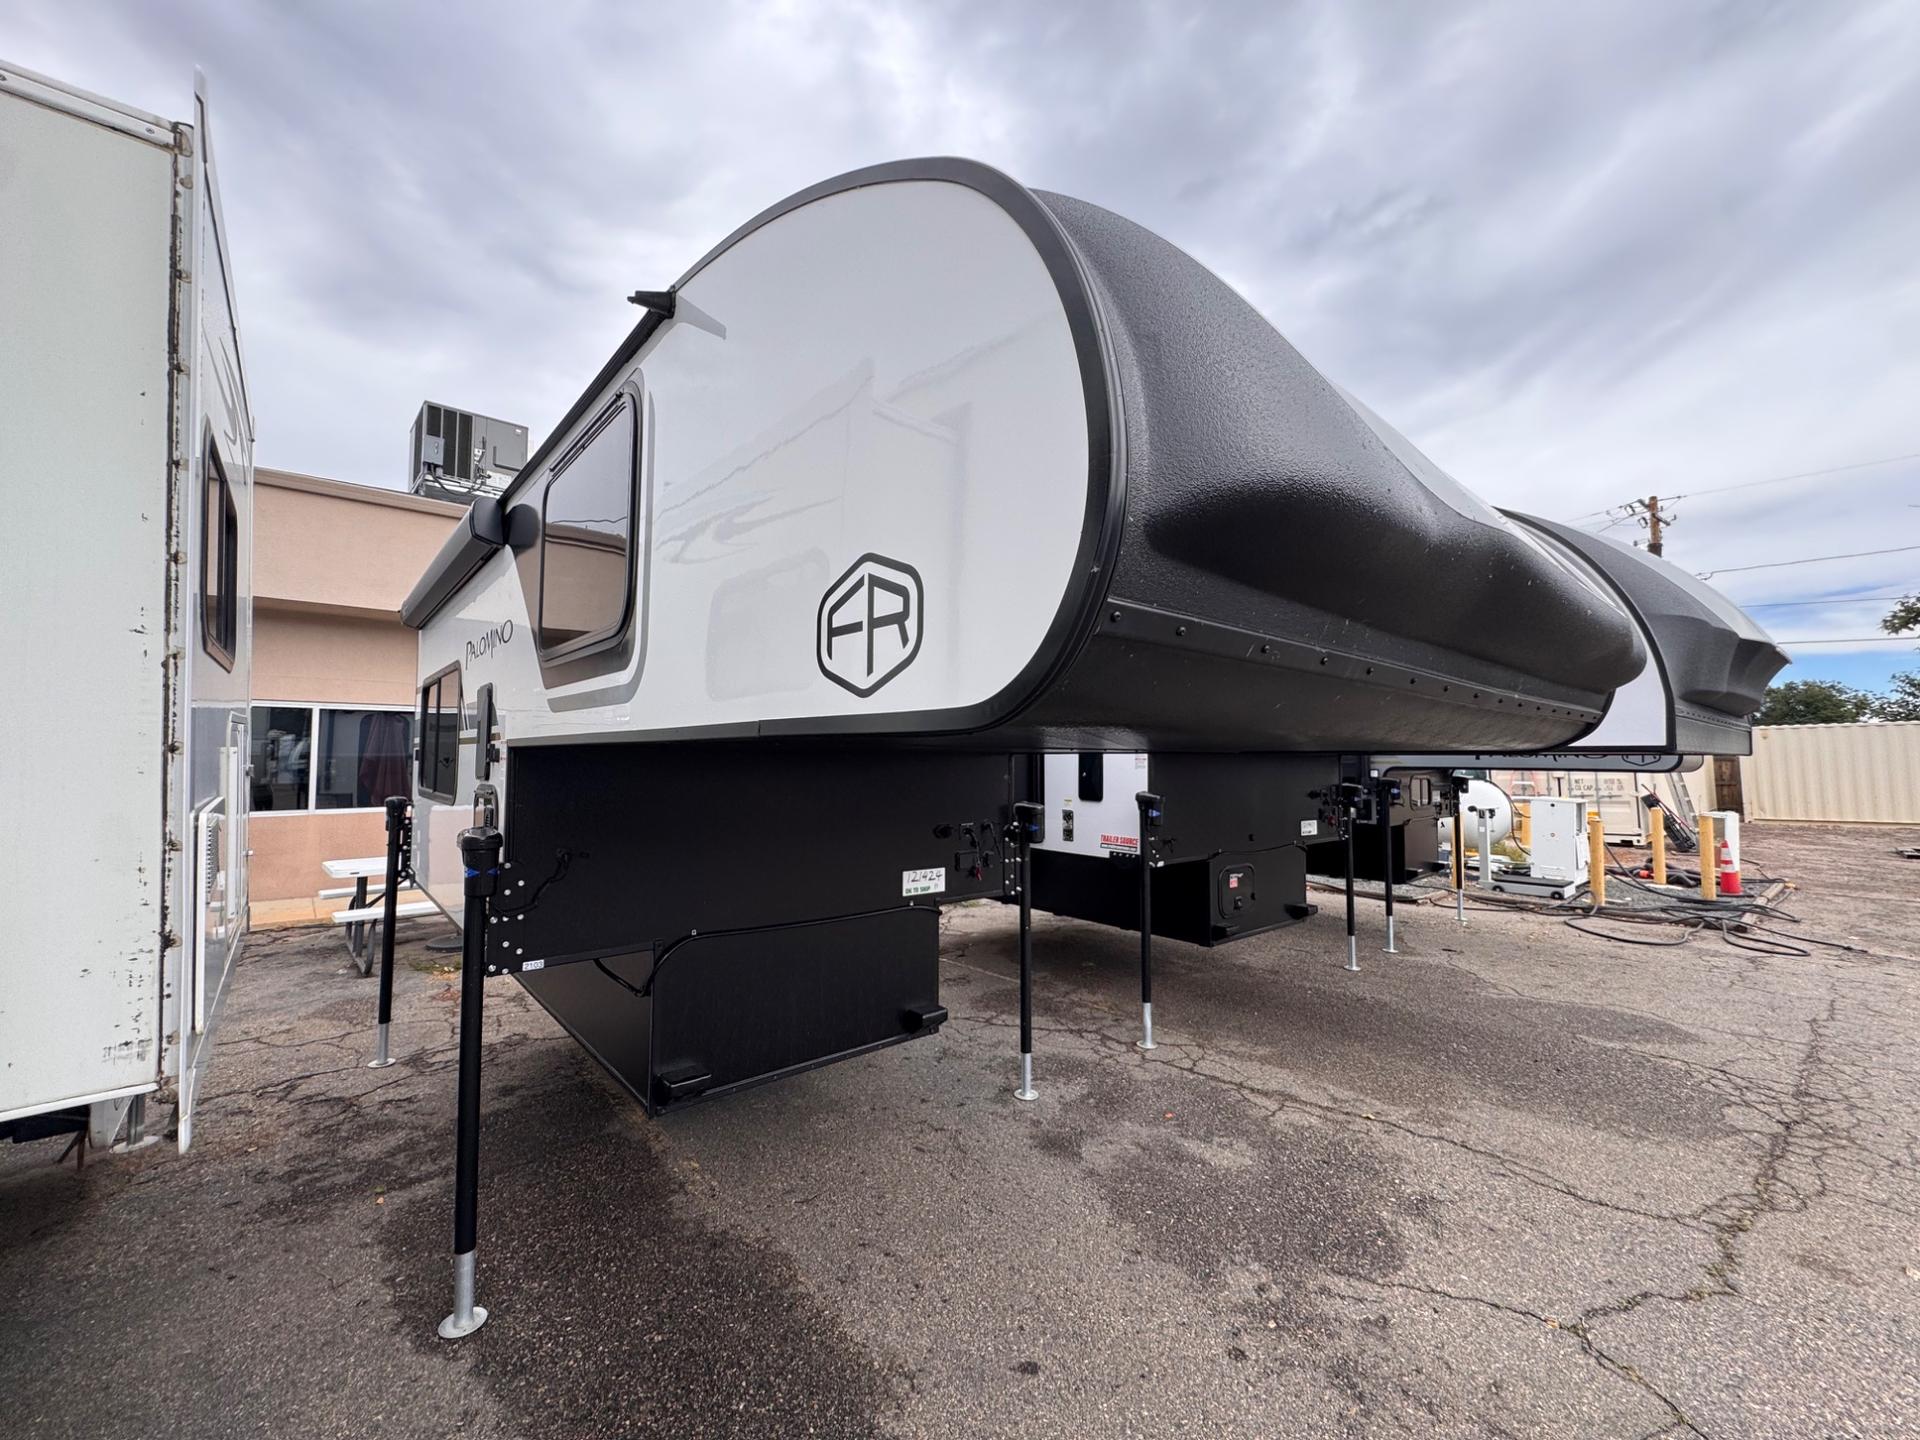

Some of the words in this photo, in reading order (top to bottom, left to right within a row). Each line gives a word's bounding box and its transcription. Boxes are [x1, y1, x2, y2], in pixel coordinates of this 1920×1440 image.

[465, 619, 513, 671] PALOMINO
[826, 572, 911, 678] FR
[1101, 834, 1119, 844] TRAILER
